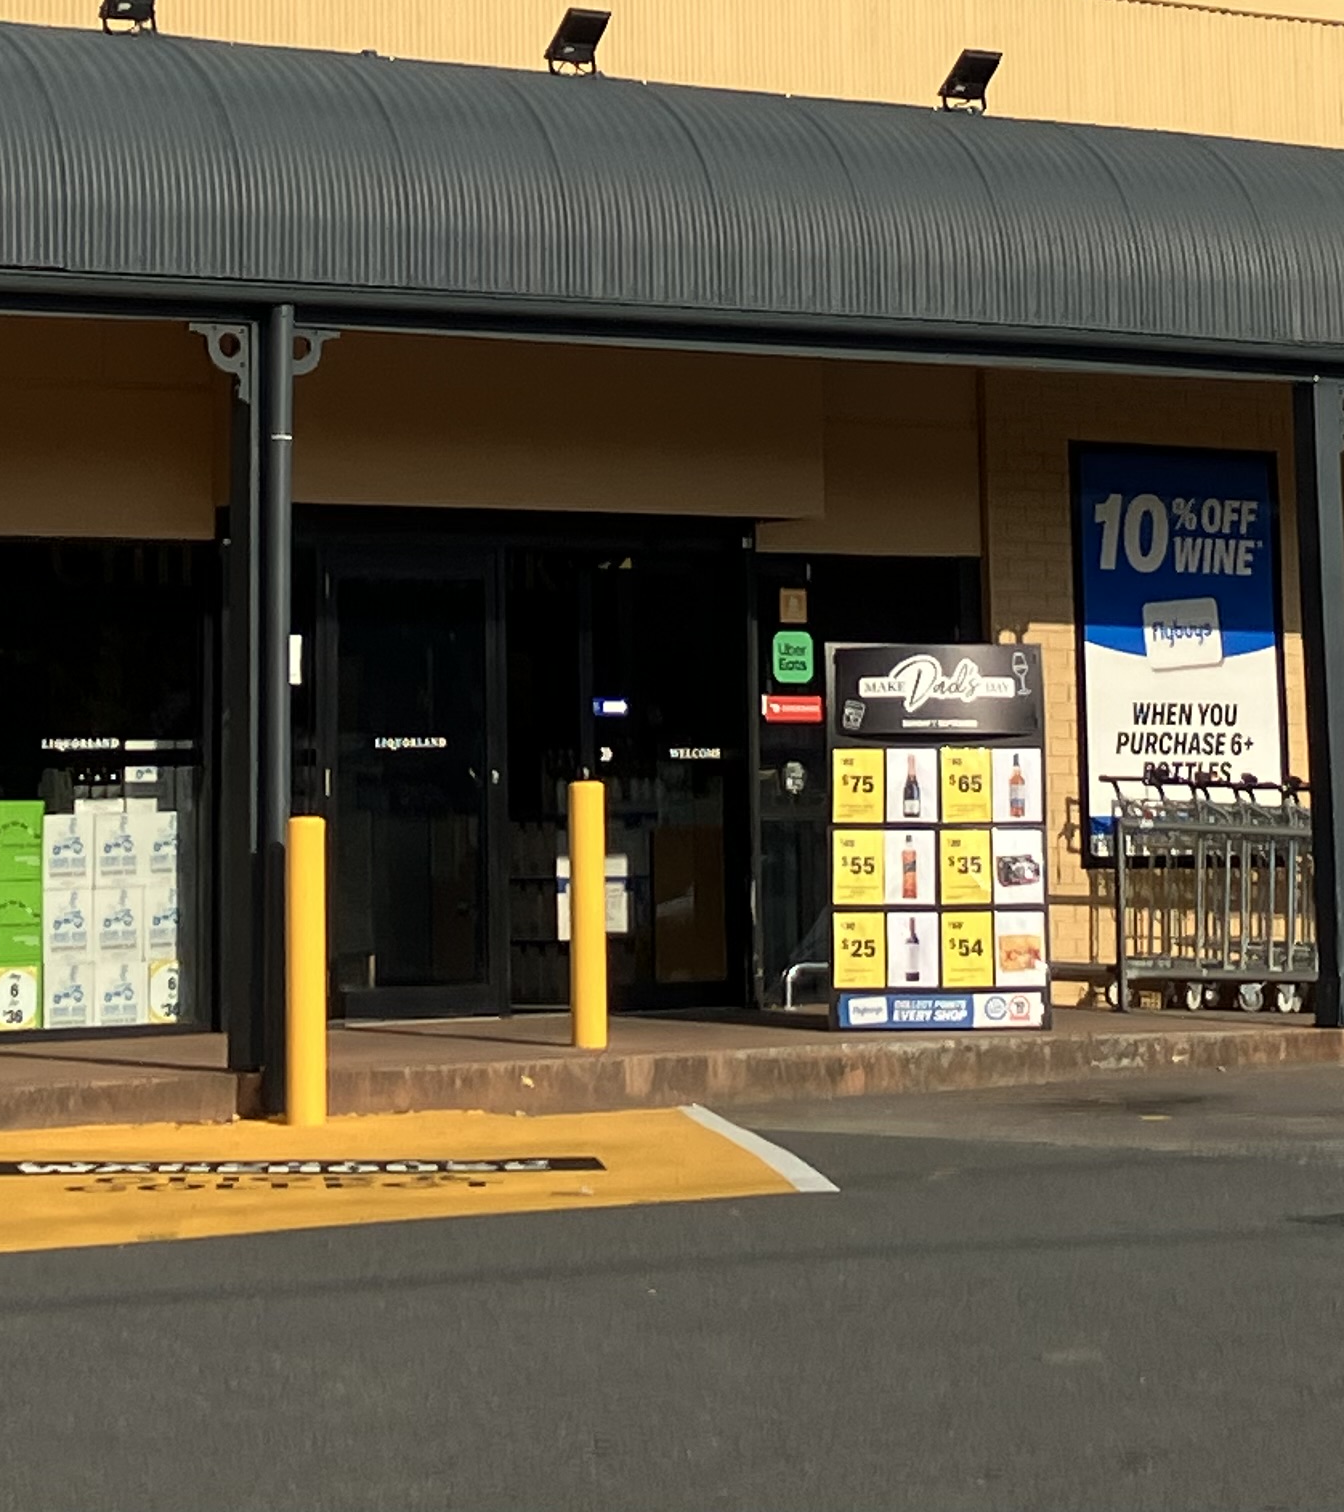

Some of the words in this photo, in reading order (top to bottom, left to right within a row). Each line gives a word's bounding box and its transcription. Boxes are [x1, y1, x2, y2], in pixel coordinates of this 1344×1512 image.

[1200, 498, 1259, 535] OFF
[1152, 618, 1213, 648] flybuys
[778, 642, 806, 656] Uber
[779, 658, 807, 672] Eats
[864, 681, 906, 693] MAKE
[894, 659, 979, 706] Dad's
[1132, 701, 1192, 727] WHEN
[1197, 703, 1238, 727] YOU
[41, 738, 120, 751] LIQUORLAND
[374, 736, 448, 751] LIQUORLAND
[669, 747, 721, 759] WELCOME
[1116, 732, 1226, 756] PURCHASE
[1230, 733, 1254, 756] 6+
[842, 774, 874, 793] $75
[949, 774, 982, 793] $65
[841, 856, 875, 875] $55
[948, 856, 982, 875] $35
[841, 938, 876, 958] $25
[949, 938, 984, 957] $54
[10, 983, 19, 997] 6
[893, 1009, 932, 1022] EVERY
[933, 1009, 968, 1022] SHOP
